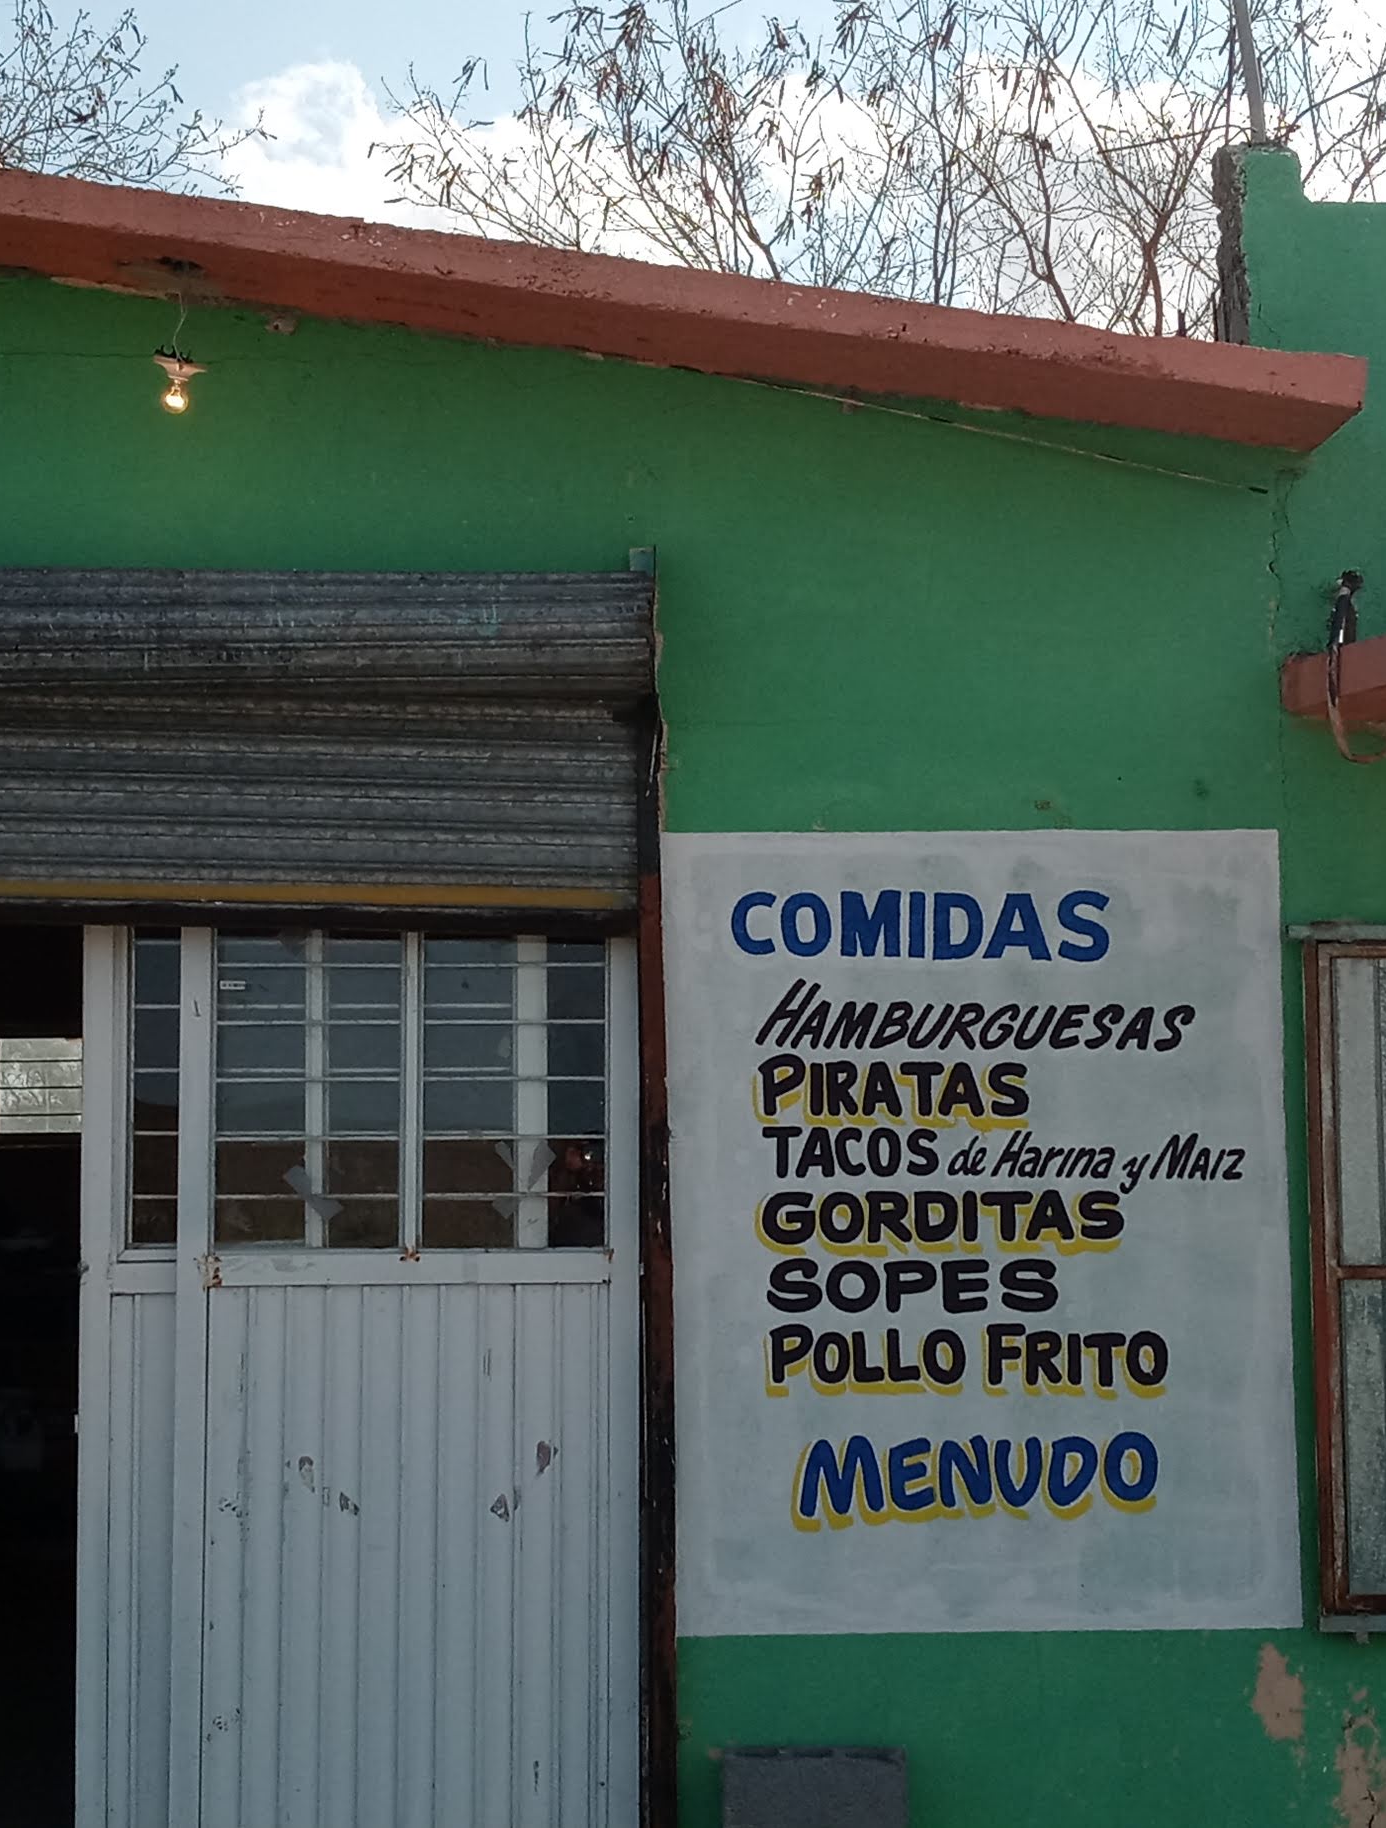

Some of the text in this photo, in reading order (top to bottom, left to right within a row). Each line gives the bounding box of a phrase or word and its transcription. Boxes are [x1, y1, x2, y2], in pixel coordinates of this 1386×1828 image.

[729, 888, 1111, 964] COMIDAS
[753, 977, 1197, 1054] HAMBURGUESAS
[756, 1052, 1031, 1130] PIRATAS
[760, 1124, 941, 1180] TACOS
[946, 1134, 989, 1178] de
[989, 1128, 1117, 1181] Harina
[1118, 1152, 1152, 1196] y
[755, 1189, 1126, 1254] GORDITAS
[765, 1256, 1060, 1316] SOPES
[766, 1321, 1170, 1394] POLLO FRITO
[791, 1430, 1160, 1530] MENUDO
